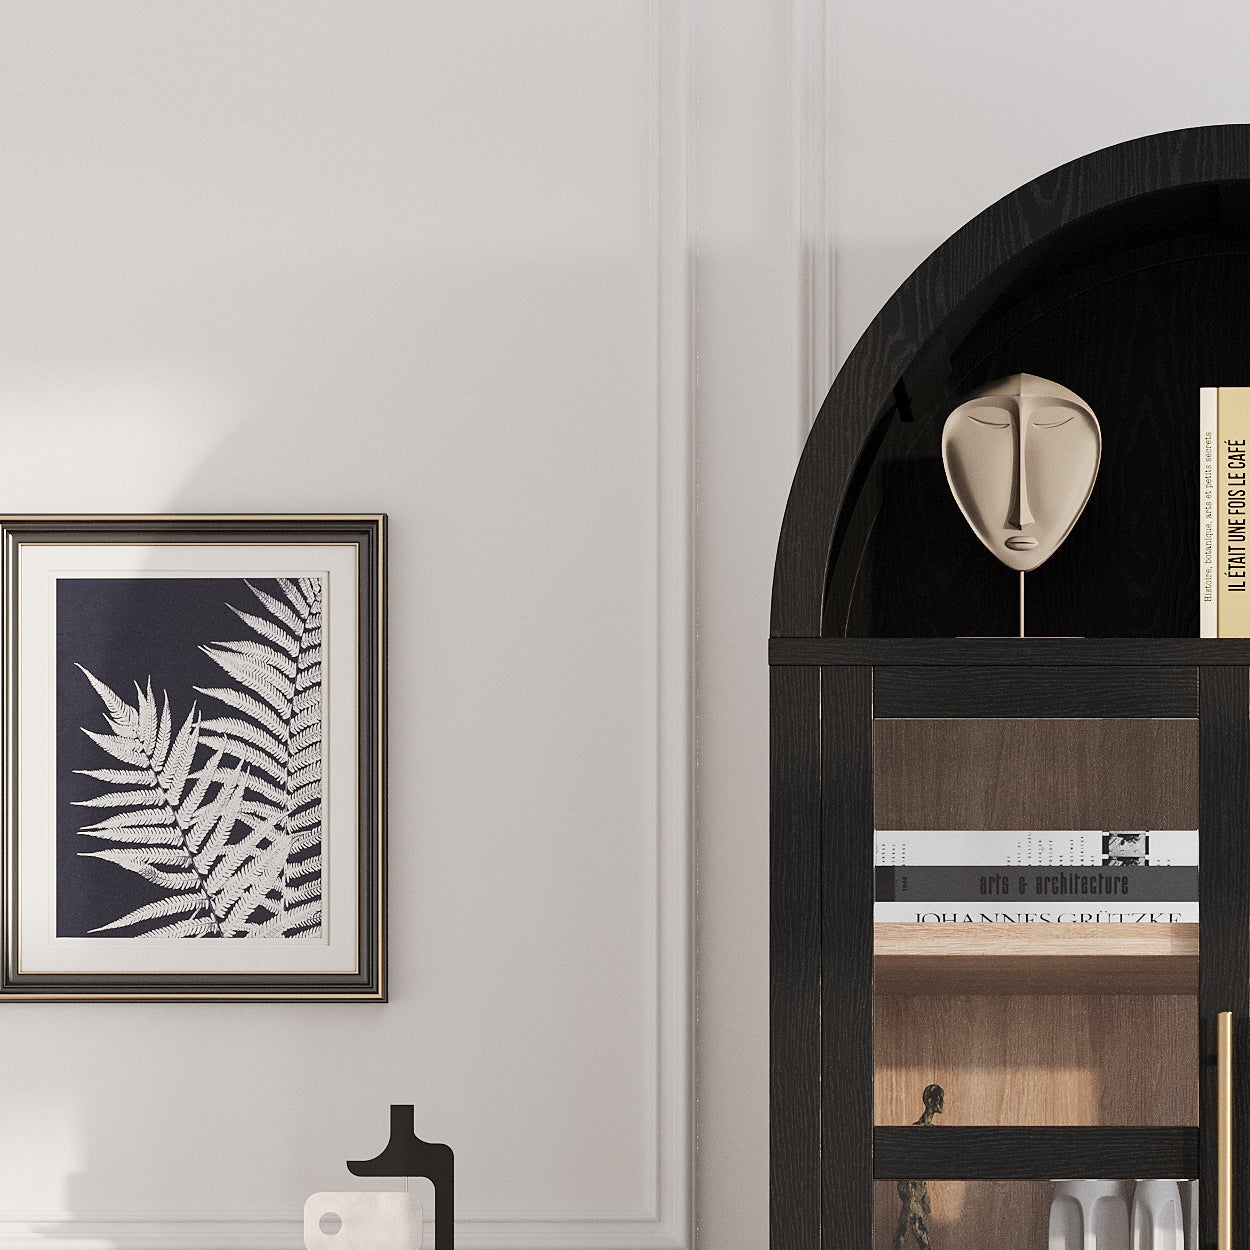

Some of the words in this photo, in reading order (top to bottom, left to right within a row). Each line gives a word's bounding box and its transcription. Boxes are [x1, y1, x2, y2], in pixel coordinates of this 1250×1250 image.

[1224, 439, 1246, 469] CAFÉ
[1204, 465, 1213, 488] petits
[1228, 472, 1246, 486] LE
[1205, 491, 1212, 499] et
[1228, 490, 1246, 515] FOIS
[1228, 519, 1246, 542] UNE
[1204, 521, 1213, 564] botanique,
[1224, 545, 1246, 578] ÉTAIT
[1204, 566, 1213, 602] Histoire,
[1228, 581, 1246, 592] IL
[980, 873, 1009, 895] arts
[1019, 875, 1027, 895] &
[1035, 872, 1129, 895] architecture
